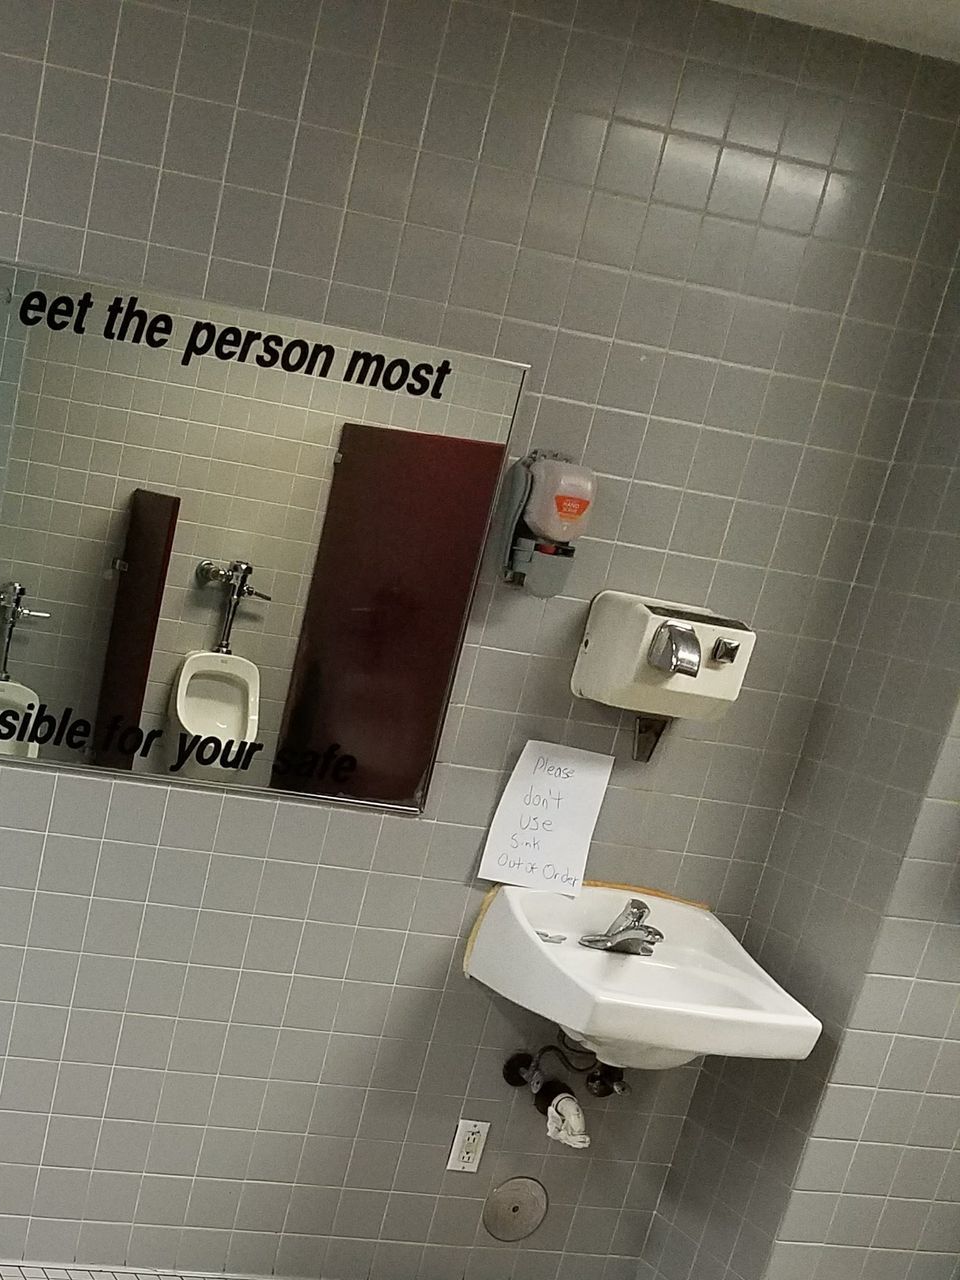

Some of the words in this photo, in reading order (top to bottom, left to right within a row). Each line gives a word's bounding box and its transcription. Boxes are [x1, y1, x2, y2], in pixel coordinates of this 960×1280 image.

[19, 290, 93, 334] eet
[102, 296, 173, 348] the
[181, 319, 335, 378] person
[343, 349, 452, 399] most
[102, 714, 163, 758] for
[169, 731, 264, 772] your
[274, 742, 358, 783] safe
[532, 756, 575, 779] Please
